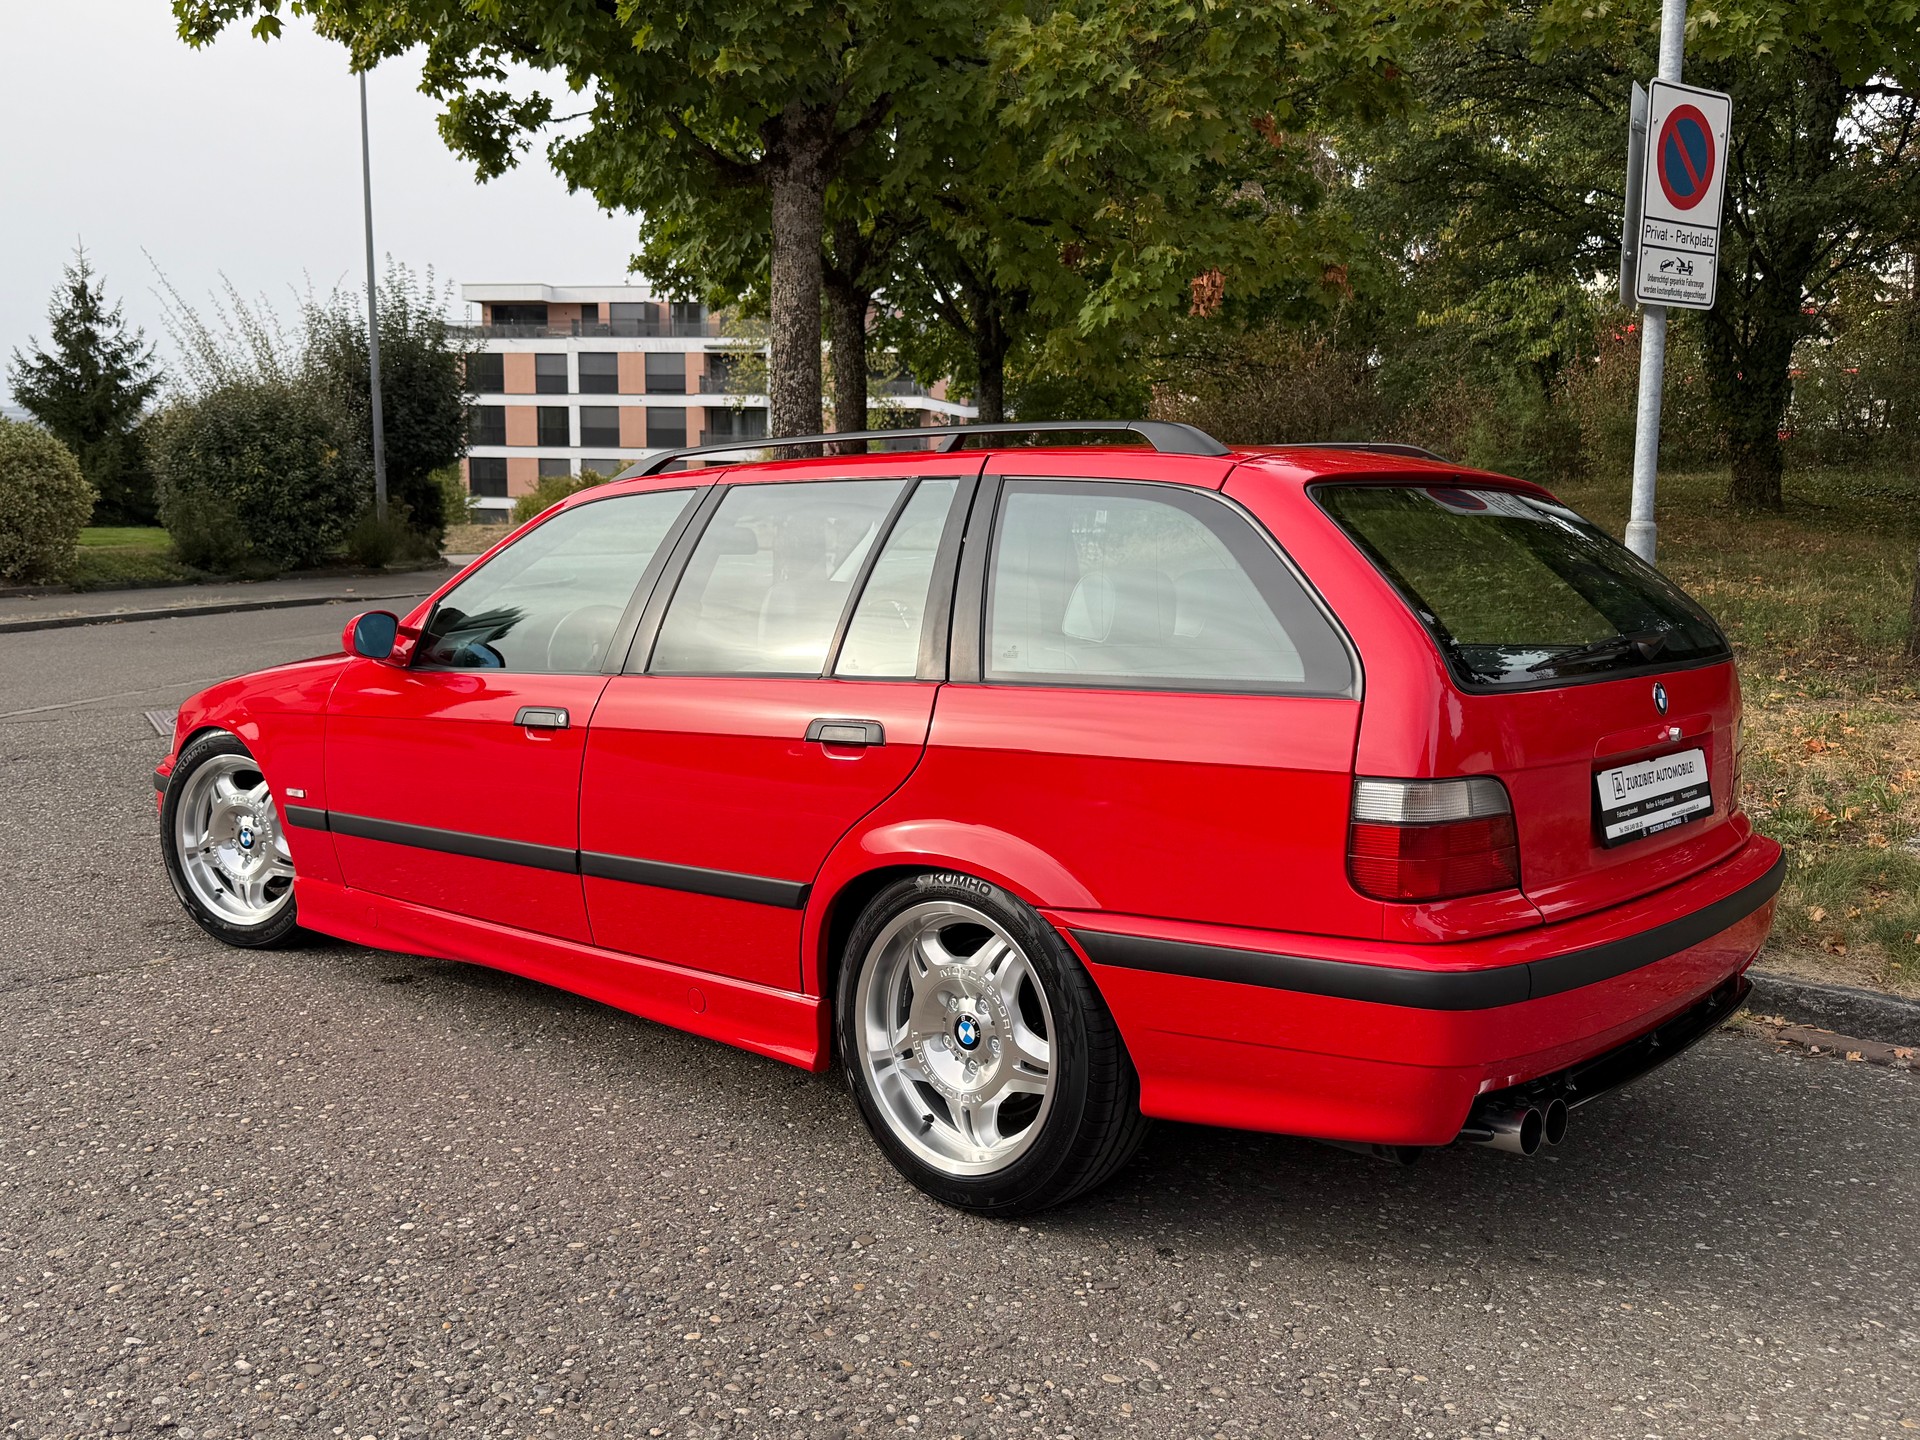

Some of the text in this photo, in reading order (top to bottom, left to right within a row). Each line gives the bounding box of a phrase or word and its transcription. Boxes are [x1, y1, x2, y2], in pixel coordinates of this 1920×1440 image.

[1645, 225, 1668, 241] Privat
[1676, 229, 1714, 248] Parkplatz
[178, 744, 208, 774] KUMHO
[1626, 772, 1655, 790] ZURZIBIET
[932, 873, 992, 897] KUMHO
[939, 967, 1013, 1042] MOTORSPORT
